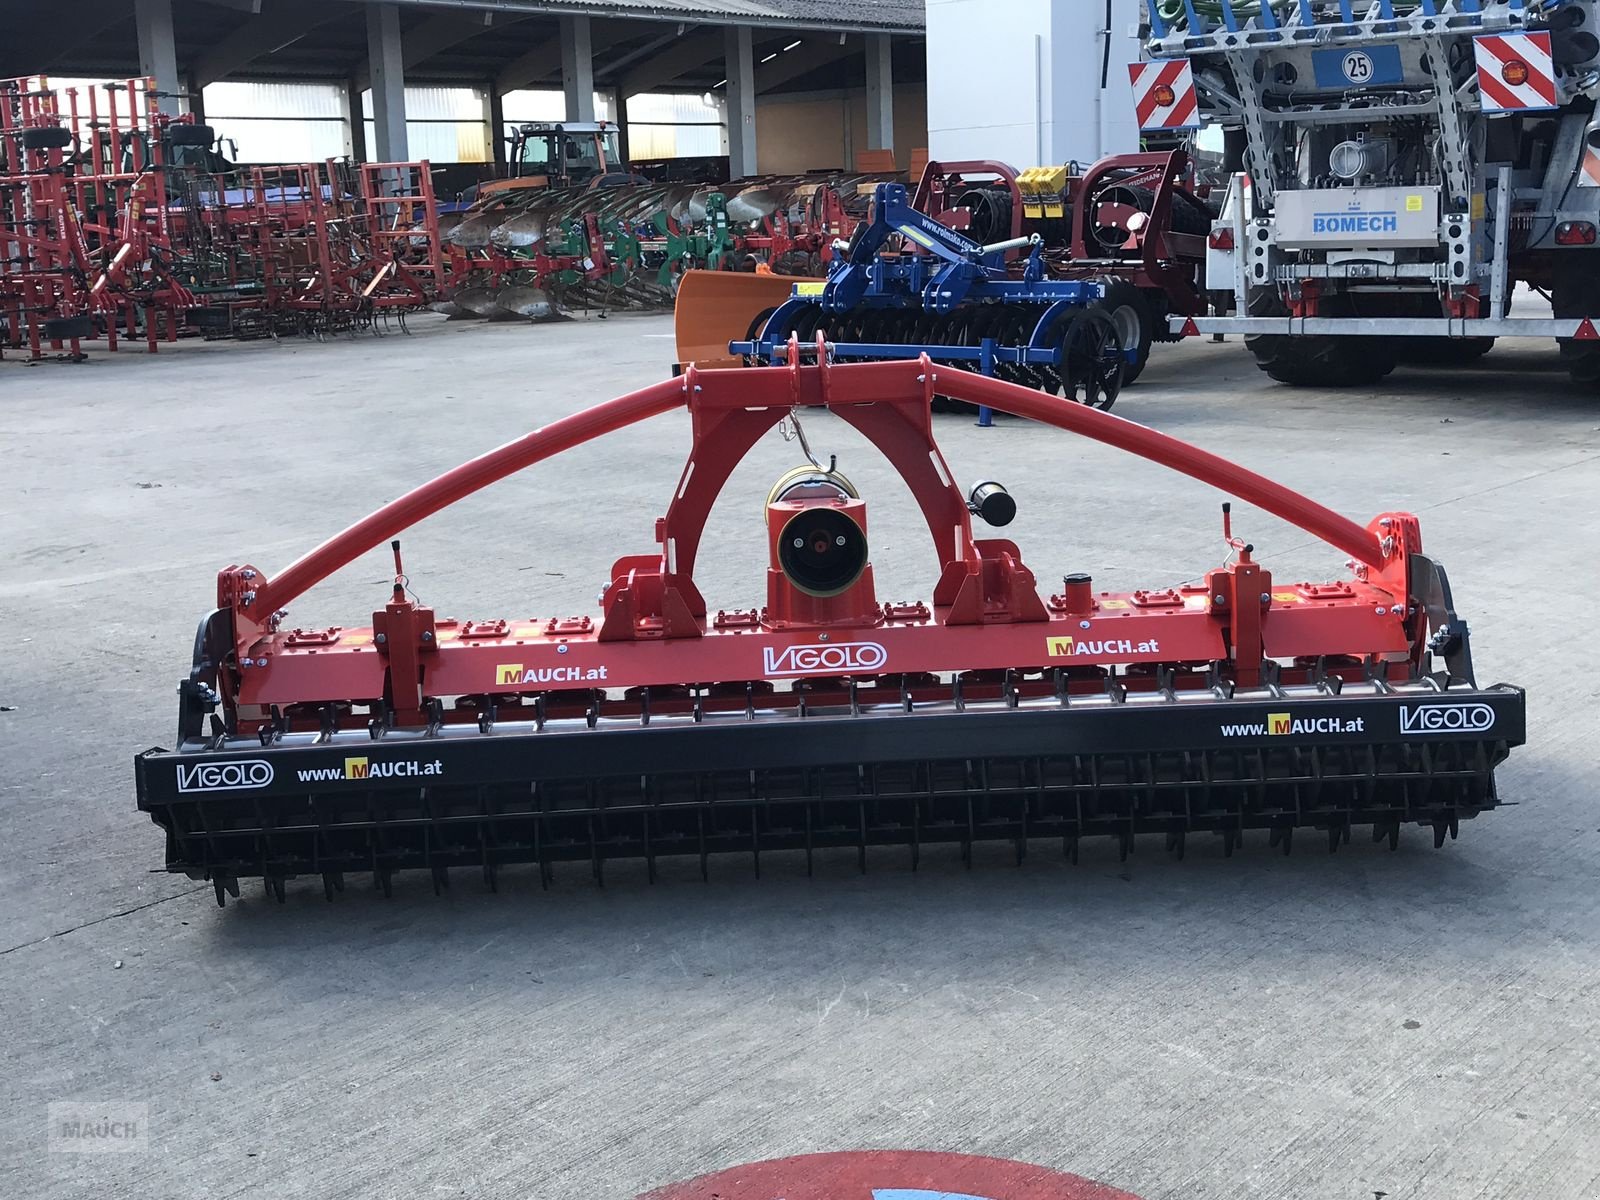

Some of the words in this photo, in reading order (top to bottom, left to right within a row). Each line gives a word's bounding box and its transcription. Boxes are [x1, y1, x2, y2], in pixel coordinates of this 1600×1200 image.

[1348, 57, 1368, 77] 25
[1313, 216, 1396, 233] BOMECH
[1054, 639, 1160, 656] MAUCH.at
[763, 642, 888, 676] VIGOLO
[503, 665, 608, 683] MAUCH.at
[1221, 716, 1364, 737] www.MAUCH.at
[1400, 703, 1496, 734] VIGOLO
[176, 759, 275, 793] VIGOLO
[297, 759, 442, 781] www.MAUCH.at
